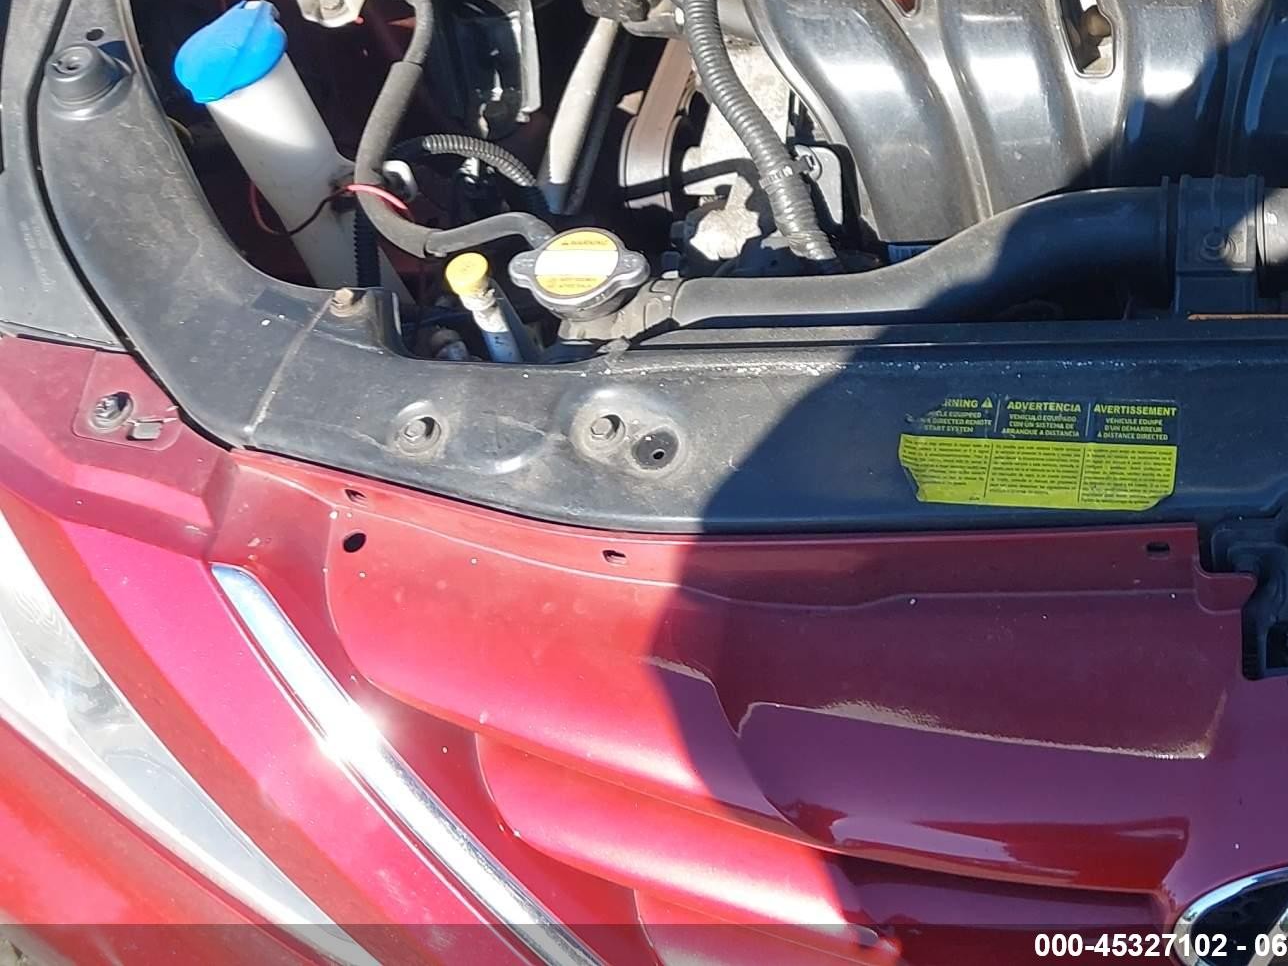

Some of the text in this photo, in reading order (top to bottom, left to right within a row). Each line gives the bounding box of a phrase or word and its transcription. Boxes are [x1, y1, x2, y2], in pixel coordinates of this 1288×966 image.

[942, 398, 979, 409] RNING
[1007, 401, 1082, 413] ADVERTENCIA
[1093, 403, 1178, 416] AVERTISSEMENT
[1136, 433, 1169, 441] DIRECTED
